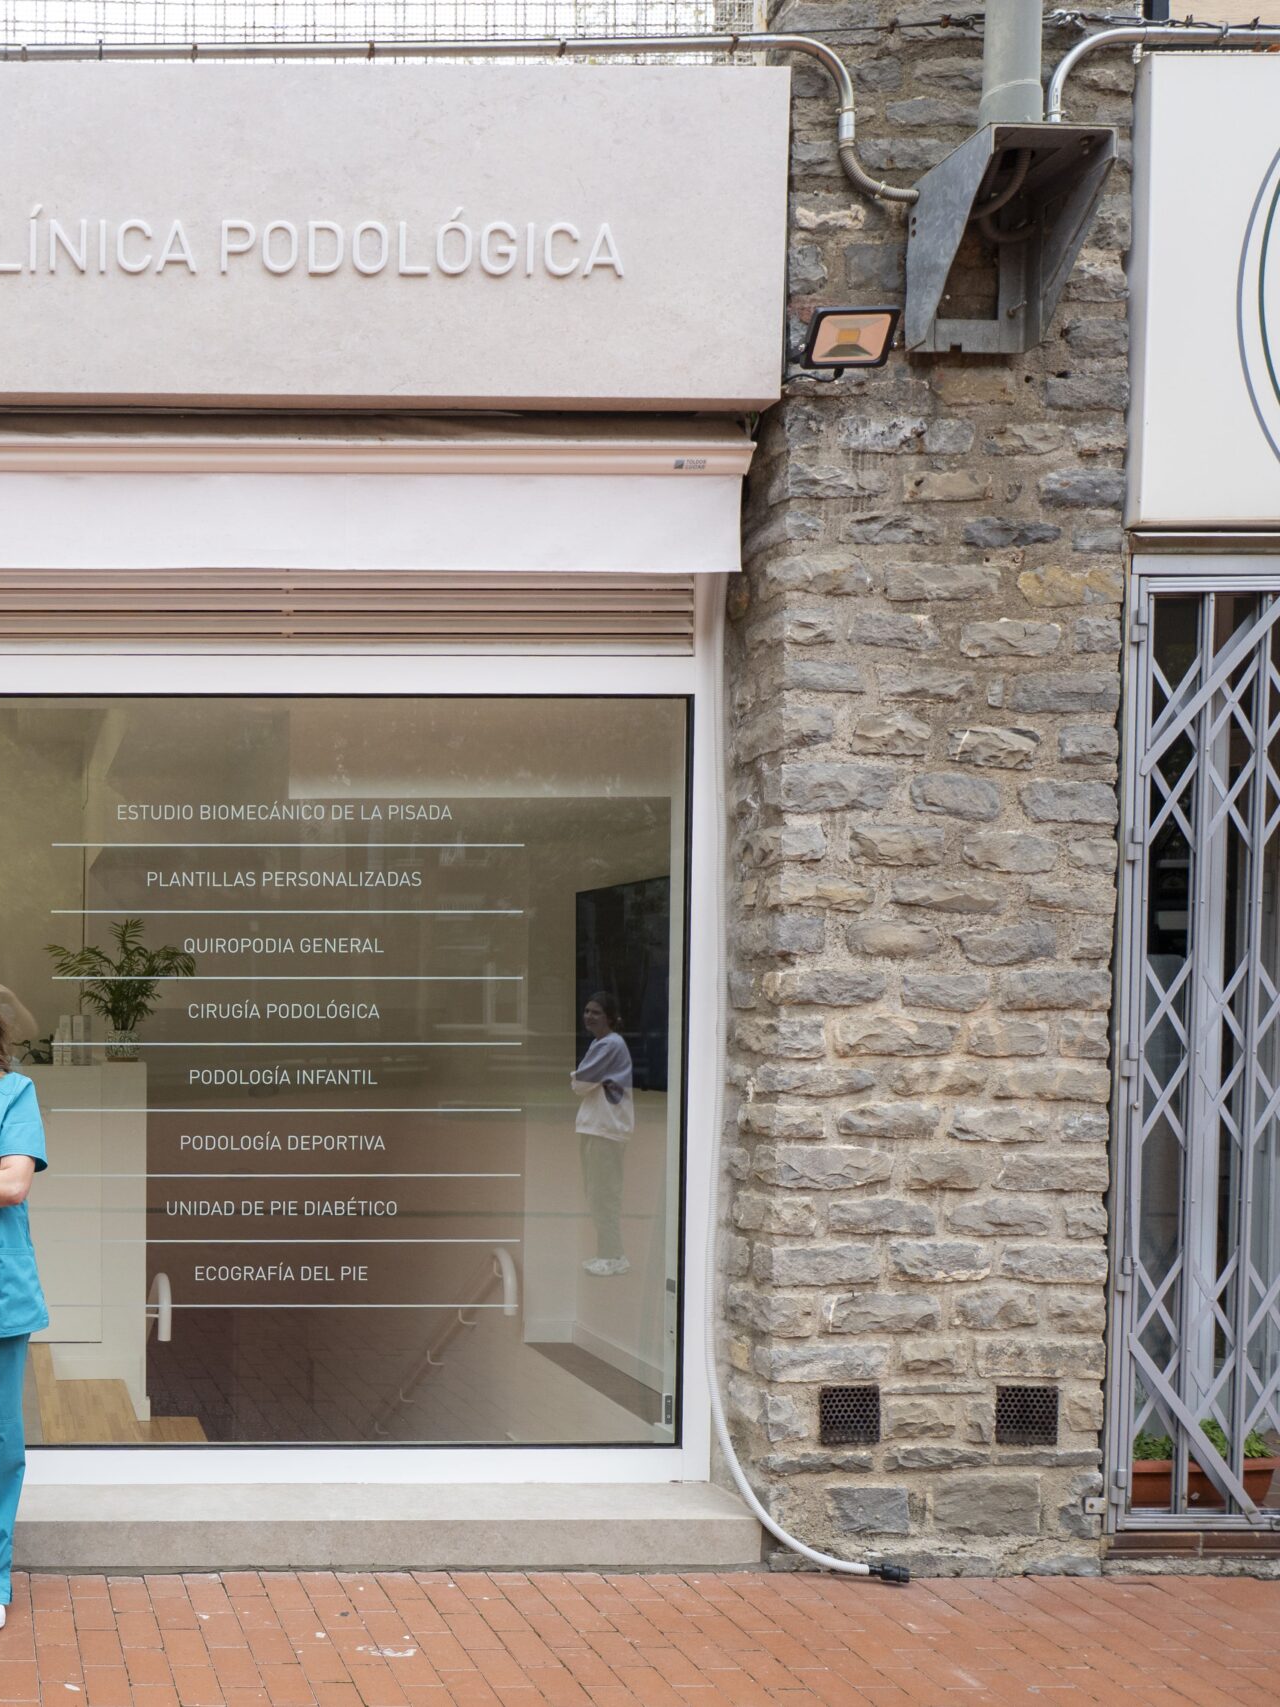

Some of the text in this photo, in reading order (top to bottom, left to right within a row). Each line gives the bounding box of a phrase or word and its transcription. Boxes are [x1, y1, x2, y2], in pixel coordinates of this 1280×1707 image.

[220, 206, 625, 279] PODOLÓGICA
[116, 800, 453, 821] ESTUDIO BIOMECÁNICO DE LA PISADA
[146, 871, 422, 887] PLANTILLAS PERSONALIZADAS
[183, 937, 385, 956] QUIROPODIA GENERAL
[187, 999, 380, 1020] CIRUGÍA PODOLÓGICA
[189, 1065, 378, 1086] PODOLOGÍA INFANTIL
[180, 1131, 386, 1151] PODOLOGÍA DEPORTIVA
[166, 1196, 398, 1217] UNIDAD DE PIE DIABÉTICO
[194, 1261, 369, 1282] ECOGRAFÍA DEL PIE
